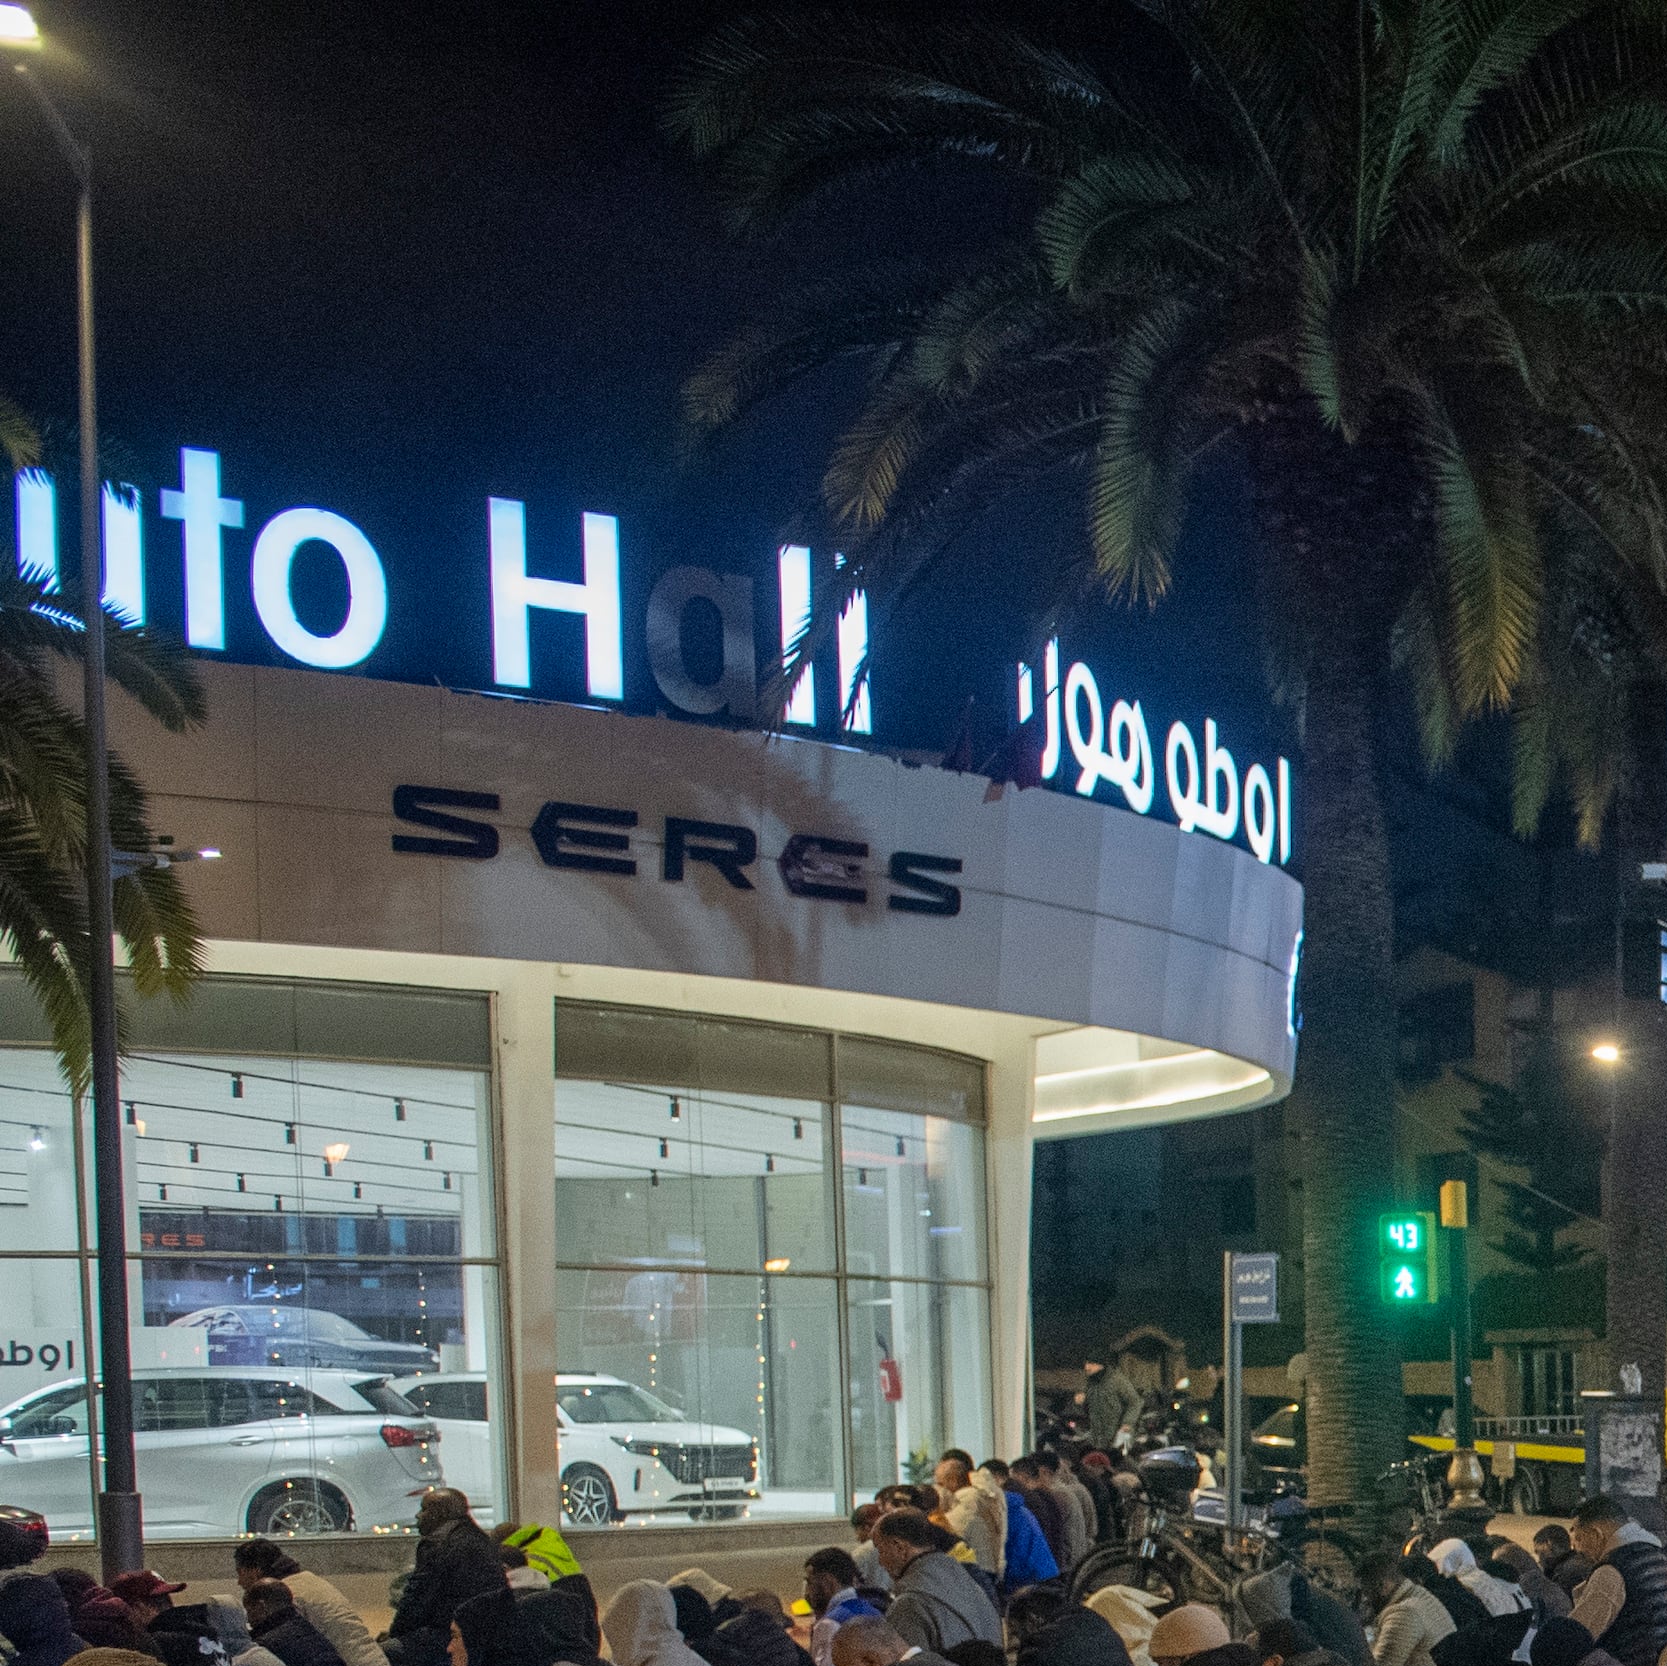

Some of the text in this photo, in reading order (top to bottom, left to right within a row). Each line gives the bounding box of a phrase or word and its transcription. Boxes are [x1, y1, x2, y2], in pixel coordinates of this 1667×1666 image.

[488, 496, 872, 735] Hall
[1389, 1223, 1418, 1249] 43
[0, 1340, 75, 1371] اوط
